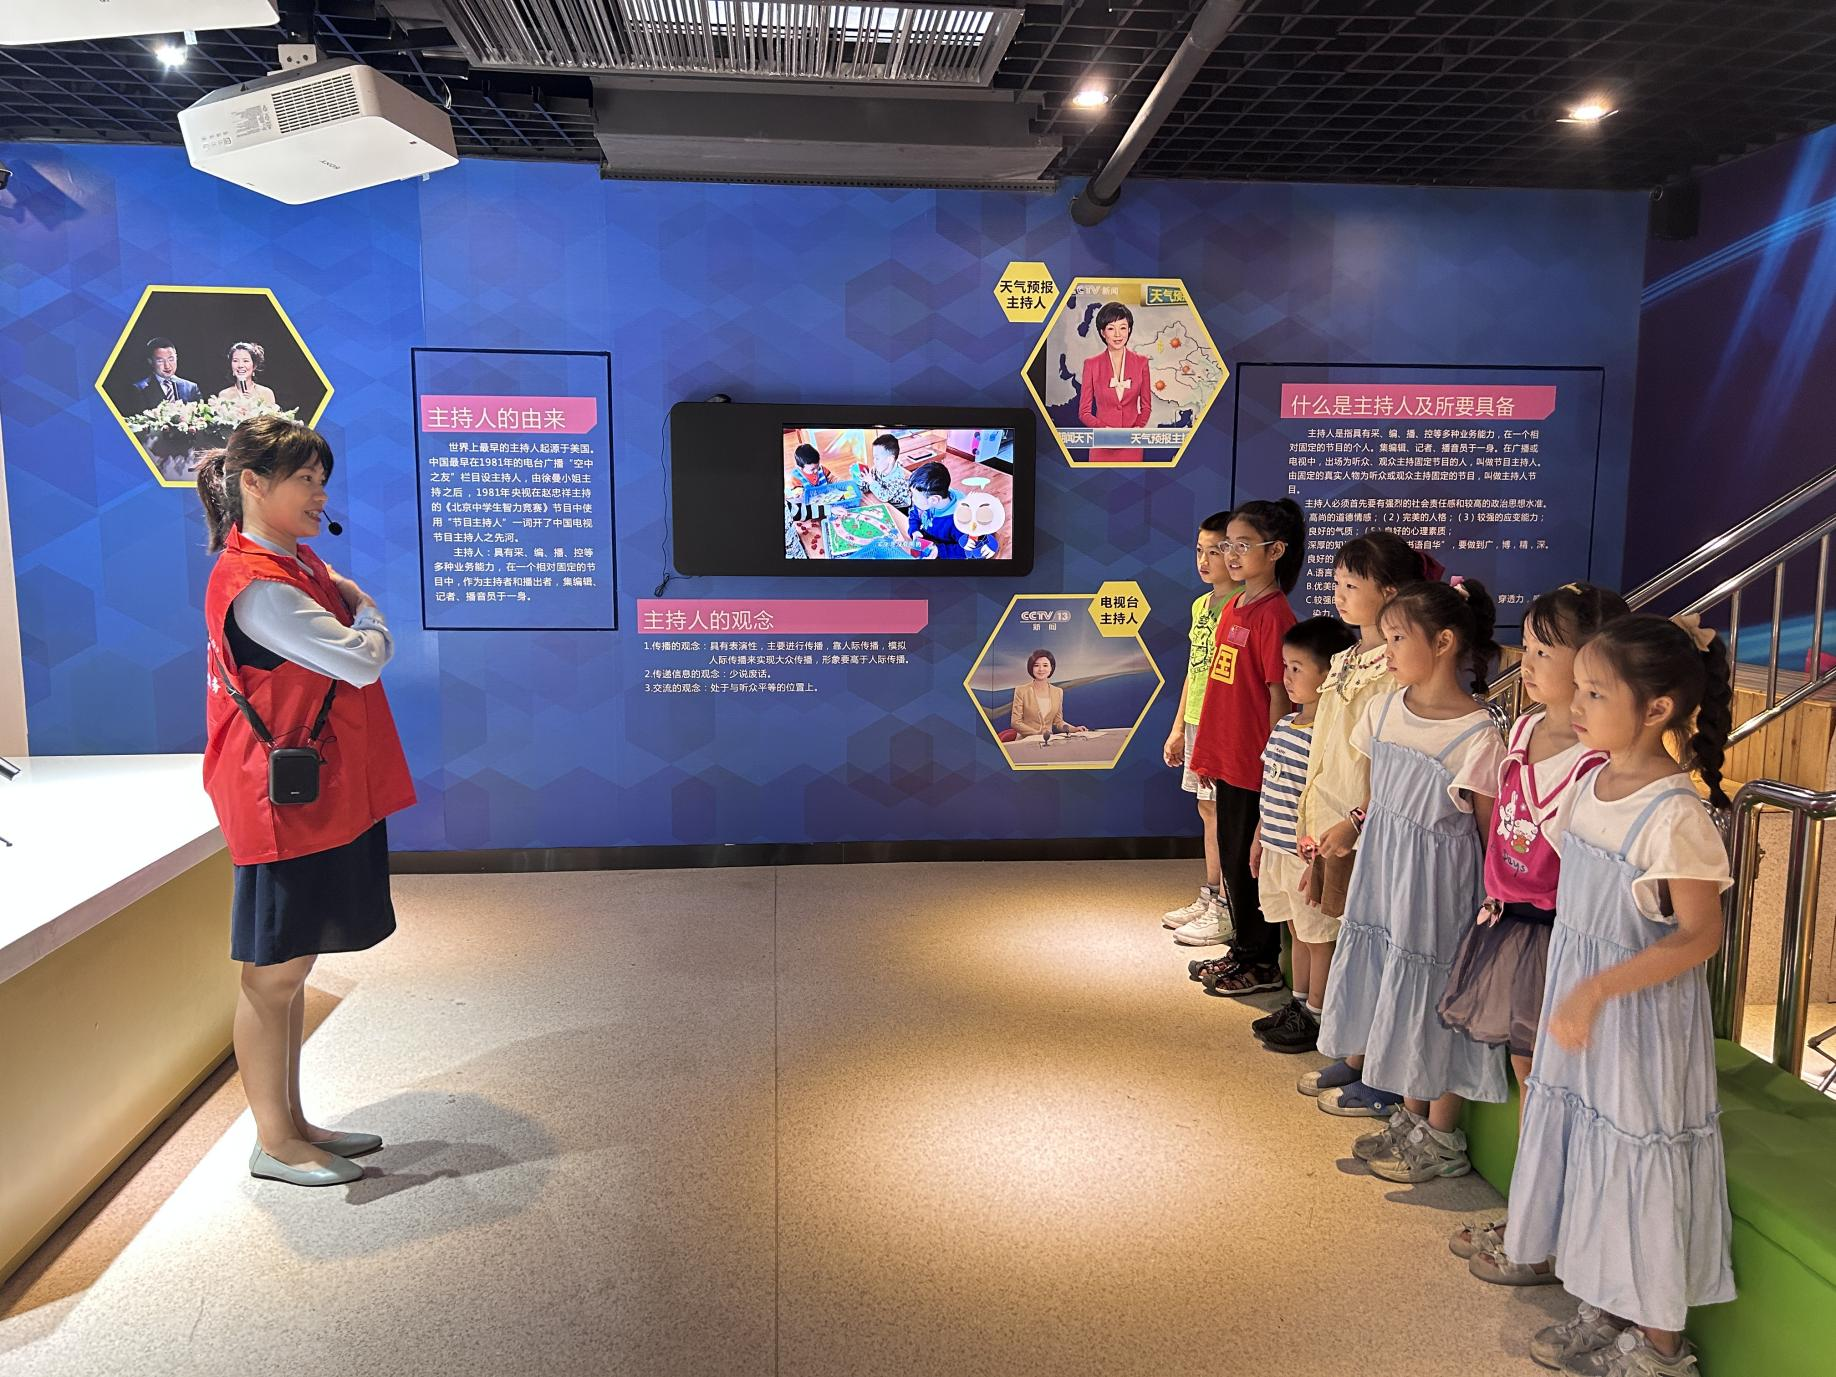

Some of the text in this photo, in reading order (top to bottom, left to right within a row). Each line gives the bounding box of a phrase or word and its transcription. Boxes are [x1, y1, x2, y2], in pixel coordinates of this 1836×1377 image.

[999, 280, 1053, 294] 天气预报
[1007, 296, 1046, 310] 主持人
[1291, 395, 1515, 417] 什么是主持人及所要具备
[427, 406, 566, 430] 主持人的由来
[1130, 433, 1185, 444] 天气预报主
[1288, 485, 1300, 495] 目。
[1100, 595, 1139, 609] 电视台
[643, 609, 774, 631] 主持人的观念
[1021, 611, 1069, 621] CCTV 13
[1100, 612, 1138, 625] 主持人
